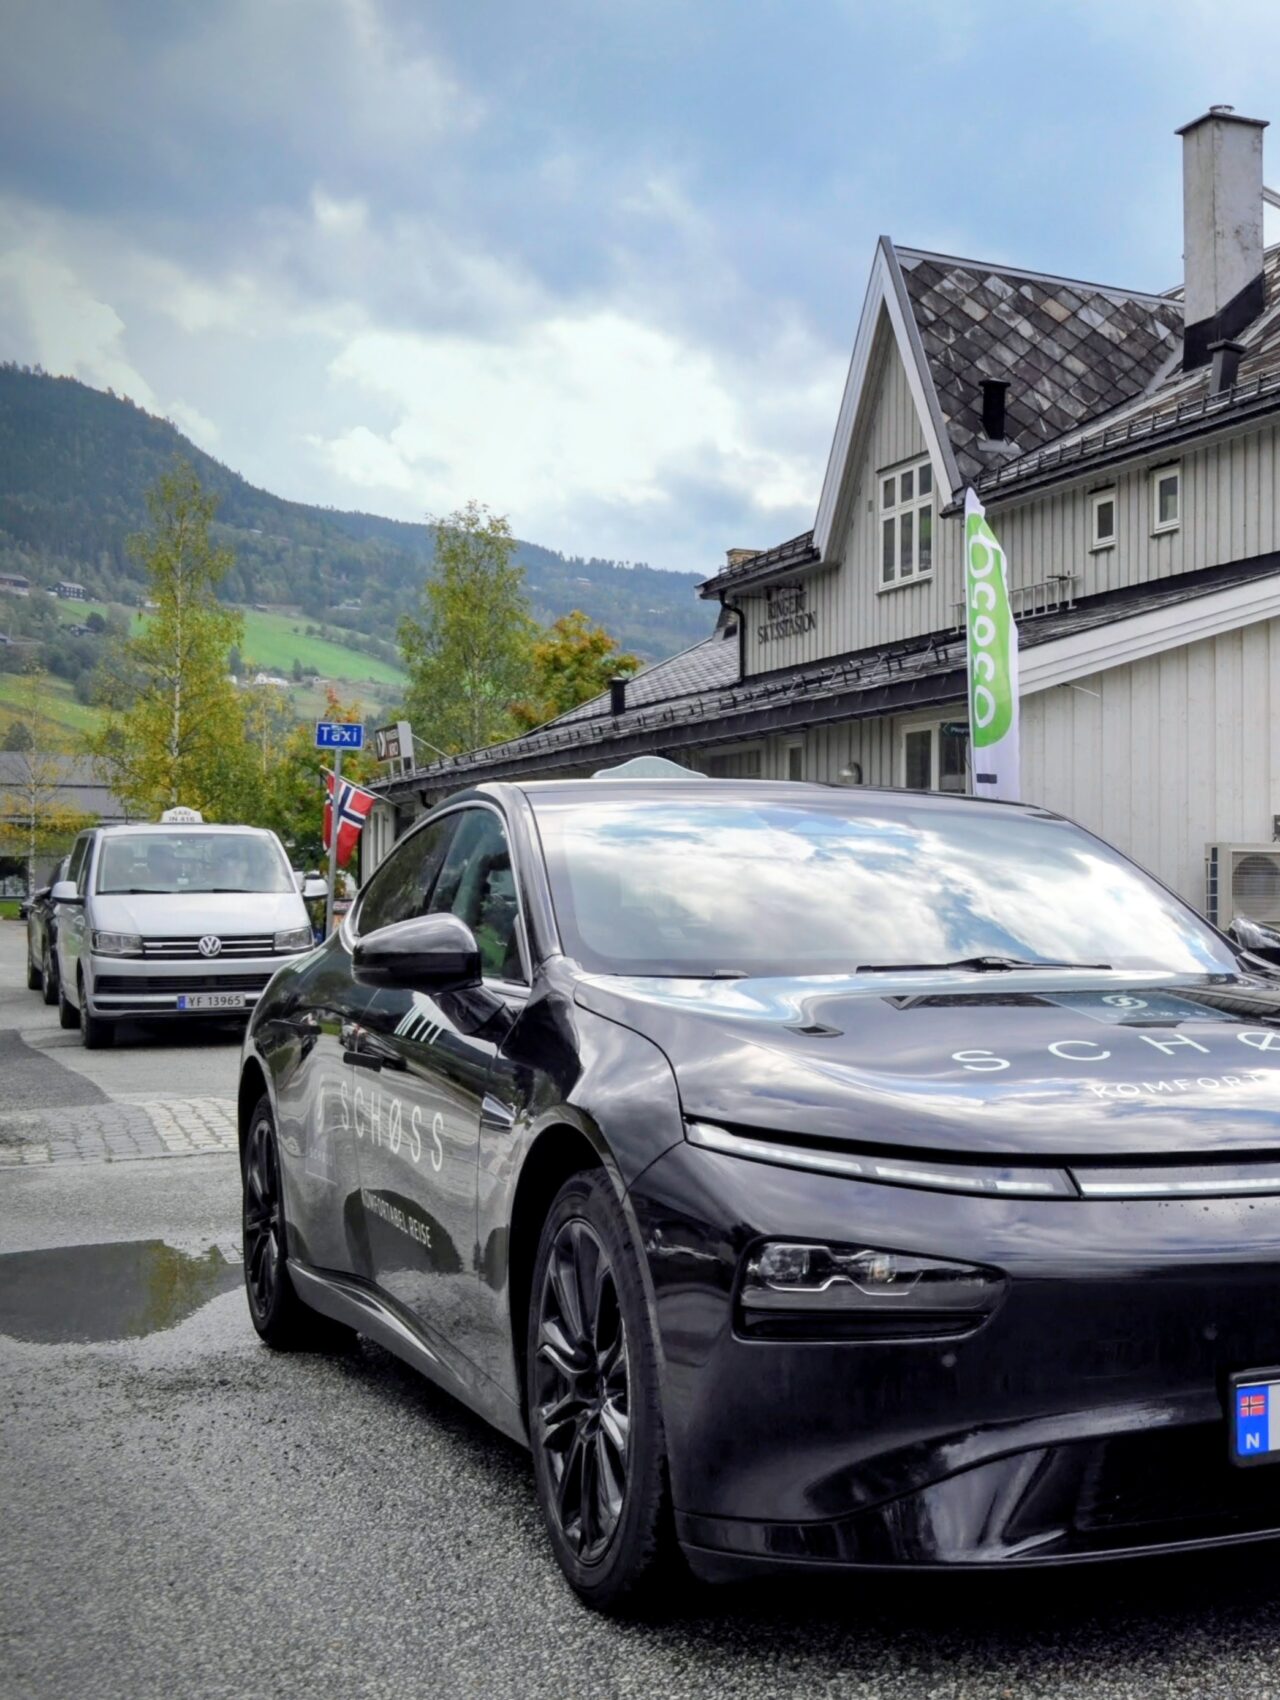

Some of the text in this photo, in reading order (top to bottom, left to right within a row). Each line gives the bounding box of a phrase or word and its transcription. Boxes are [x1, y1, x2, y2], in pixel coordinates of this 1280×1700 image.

[320, 726, 358, 742] Taxi
[208, 995, 241, 1006] 13965
[340, 1080, 444, 1172] SCHØSS
[1245, 1432, 1260, 1449] N
